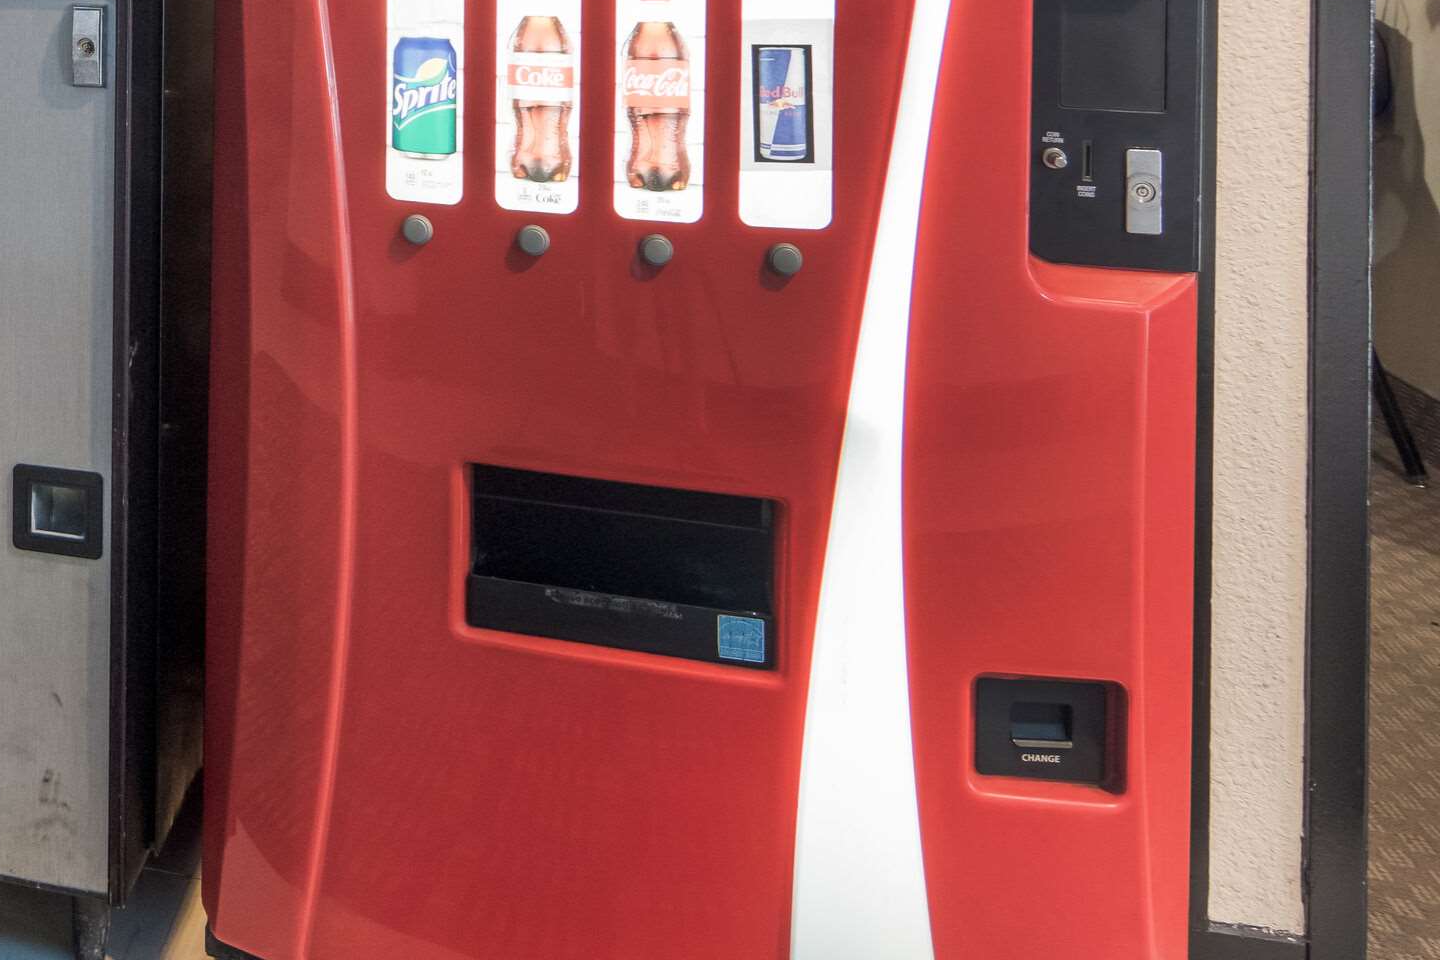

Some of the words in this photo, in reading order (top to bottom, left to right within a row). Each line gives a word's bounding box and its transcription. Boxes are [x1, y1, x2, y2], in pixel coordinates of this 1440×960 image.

[515, 66, 565, 87] Coke
[392, 73, 456, 120] Sprite
[1021, 753, 1061, 763] CHANGE
